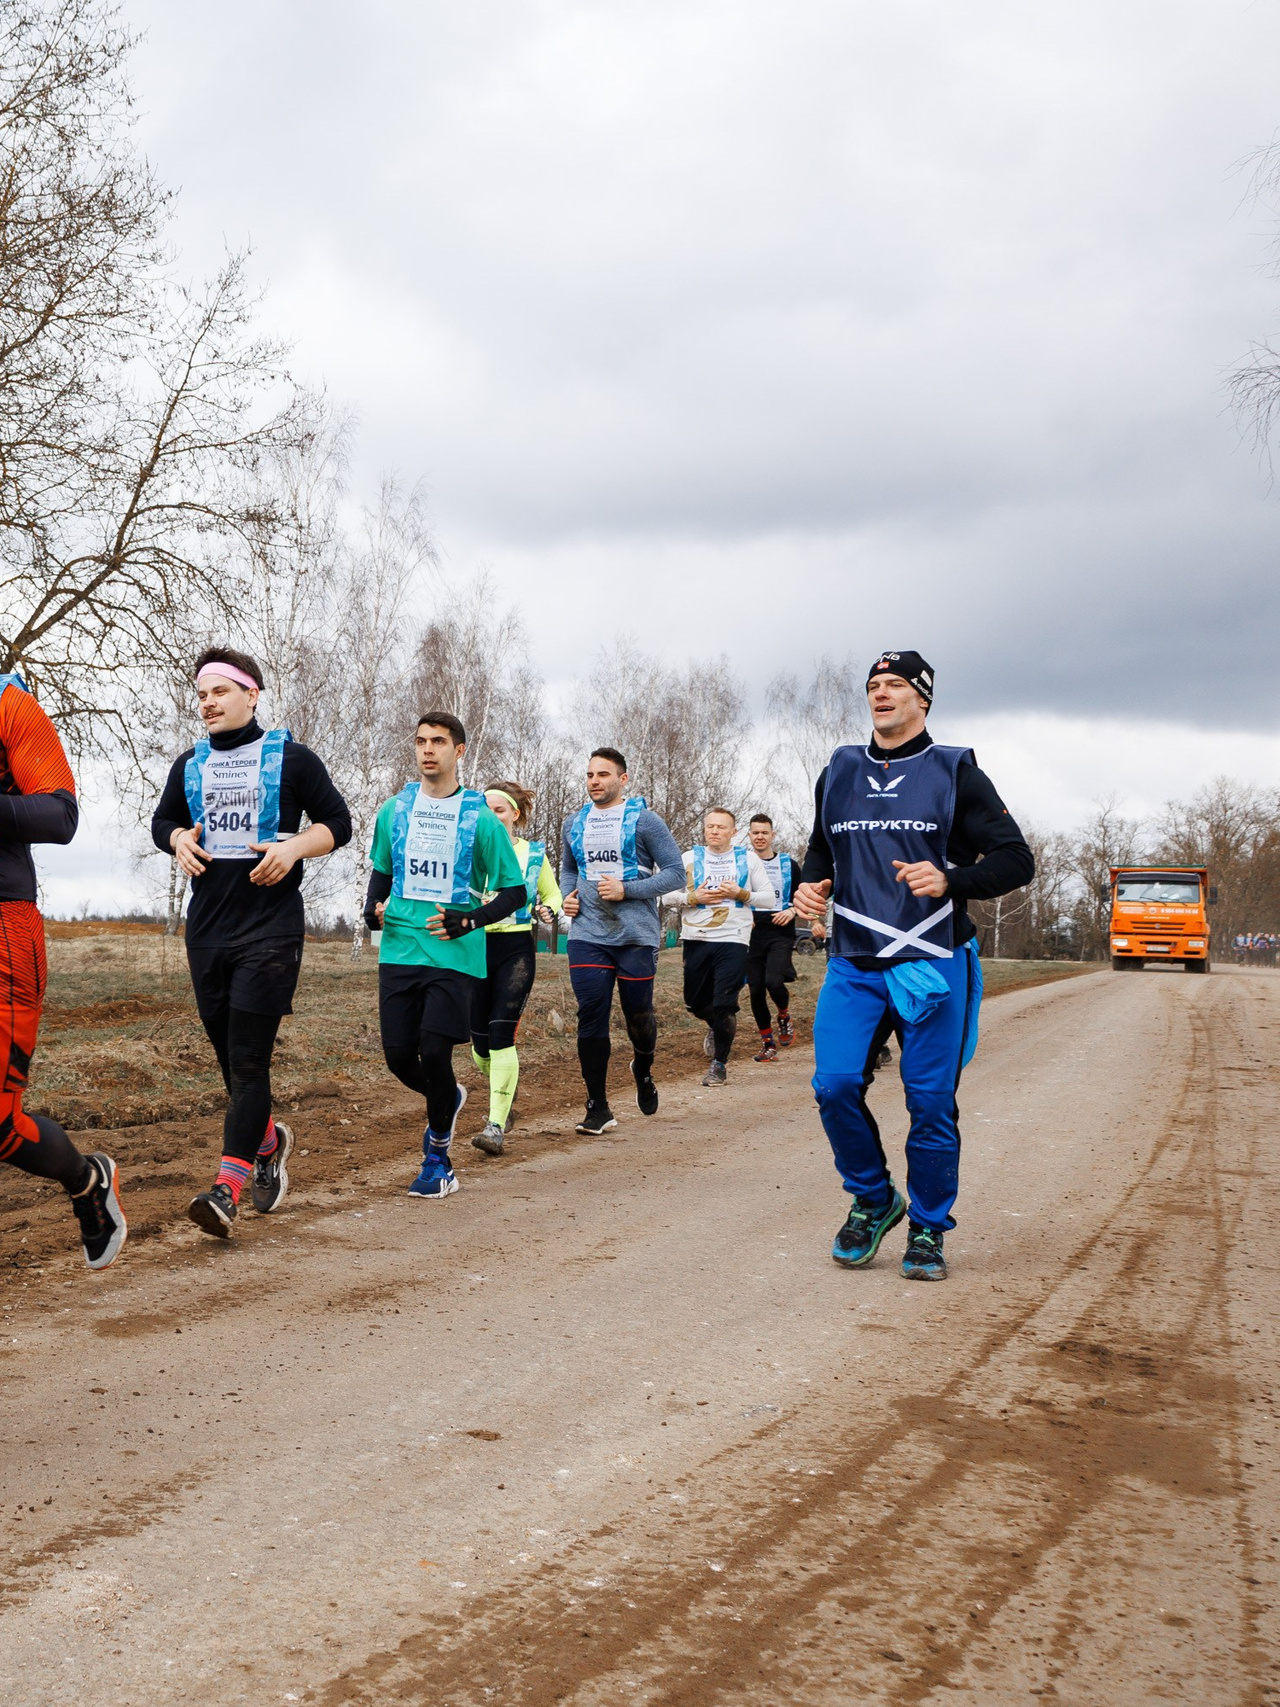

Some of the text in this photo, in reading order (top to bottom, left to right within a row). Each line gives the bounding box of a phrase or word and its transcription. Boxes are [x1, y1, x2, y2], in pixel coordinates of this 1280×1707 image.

[212, 769, 248, 779] Sminex
[432, 811, 456, 819] ГЕРОЕВ
[208, 812, 252, 832] 5404
[417, 820, 448, 831] Sminex
[830, 820, 938, 835] ИНСТРУКТОР
[587, 850, 618, 863] 5406
[410, 858, 447, 879] 5411
